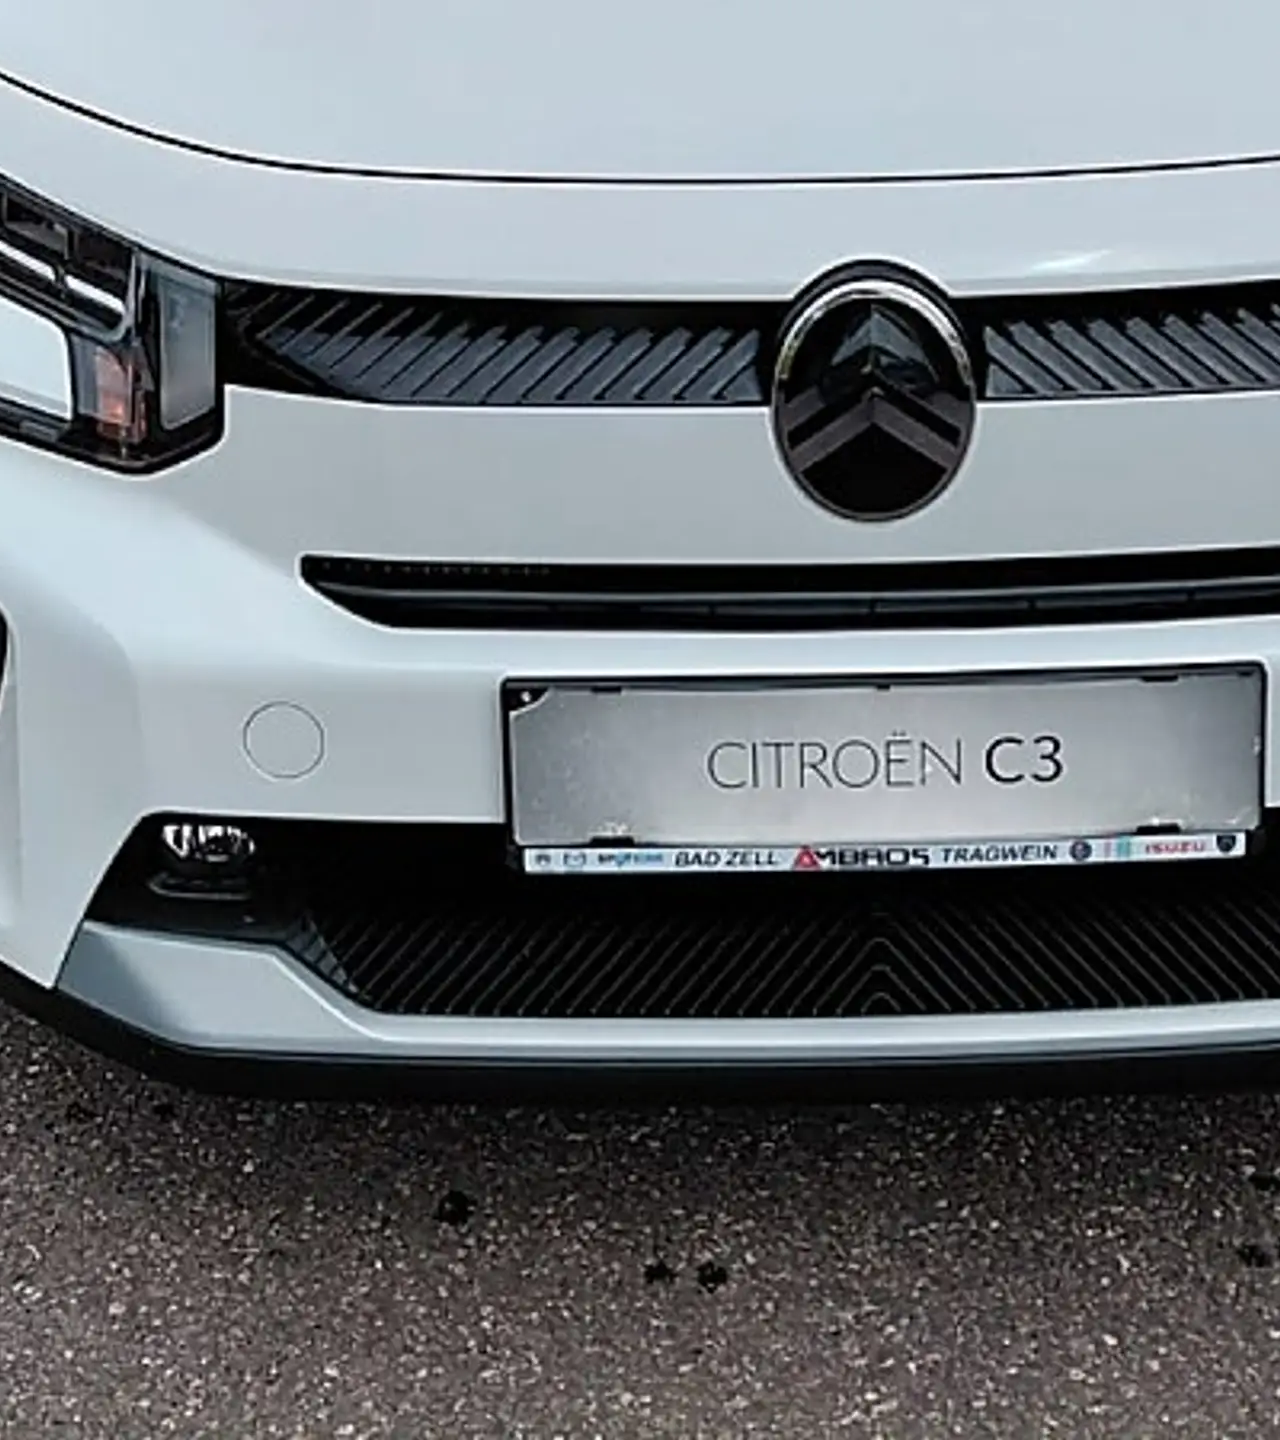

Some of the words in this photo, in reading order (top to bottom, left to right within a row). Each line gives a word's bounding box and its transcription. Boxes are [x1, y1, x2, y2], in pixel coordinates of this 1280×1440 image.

[707, 730, 963, 790] CITROËN
[984, 734, 1064, 784] C3
[675, 850, 721, 868] BAD
[724, 850, 780, 868] ZELL
[939, 843, 1060, 864] TRAGWEIN
[1144, 839, 1206, 855] ISUZU
